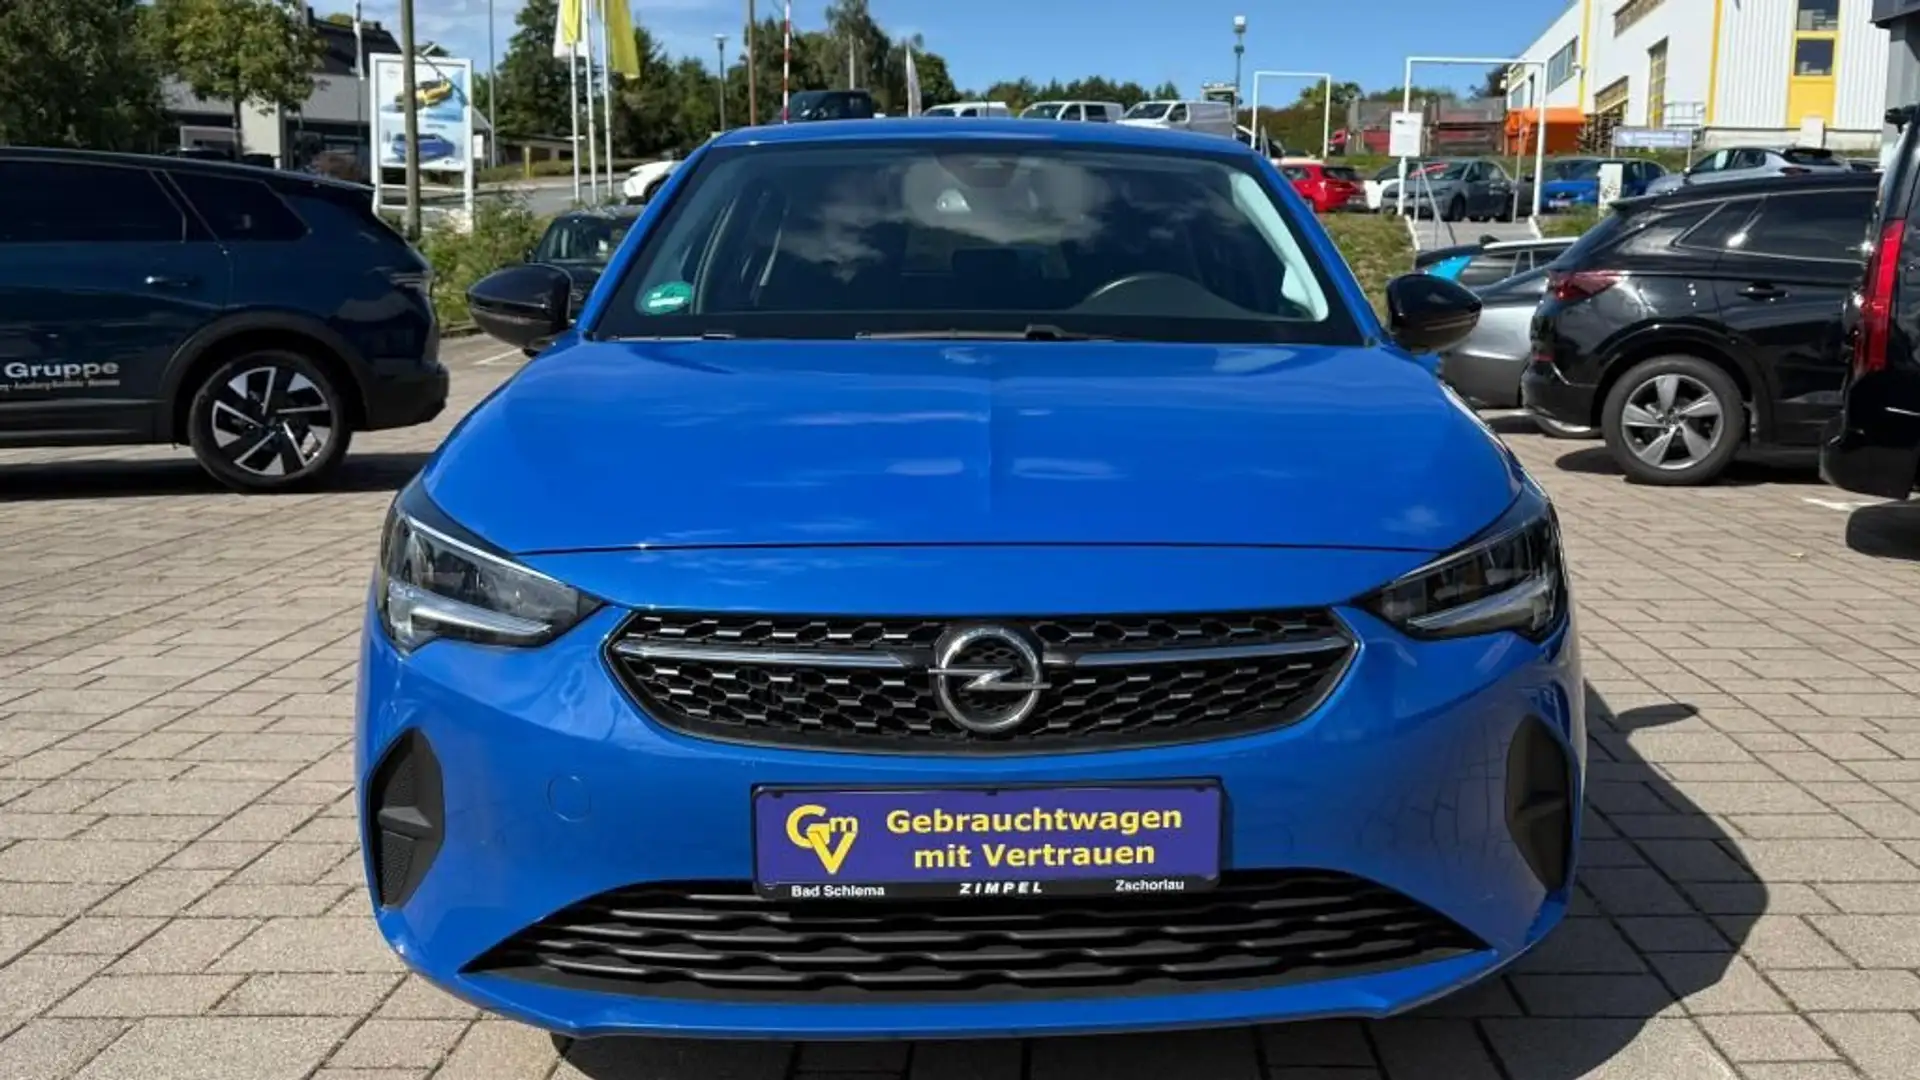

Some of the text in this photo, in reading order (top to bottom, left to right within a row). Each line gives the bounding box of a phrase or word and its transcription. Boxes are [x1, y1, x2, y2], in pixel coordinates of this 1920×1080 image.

[4, 362, 120, 378] Gruppe
[886, 807, 1182, 835] Gebrauchtwagen
[914, 843, 1156, 868] mit Vertrauen
[791, 884, 885, 897] Bad Schlema
[959, 881, 1043, 895] ZIMPEL
[1115, 879, 1185, 892] Zschorlau
